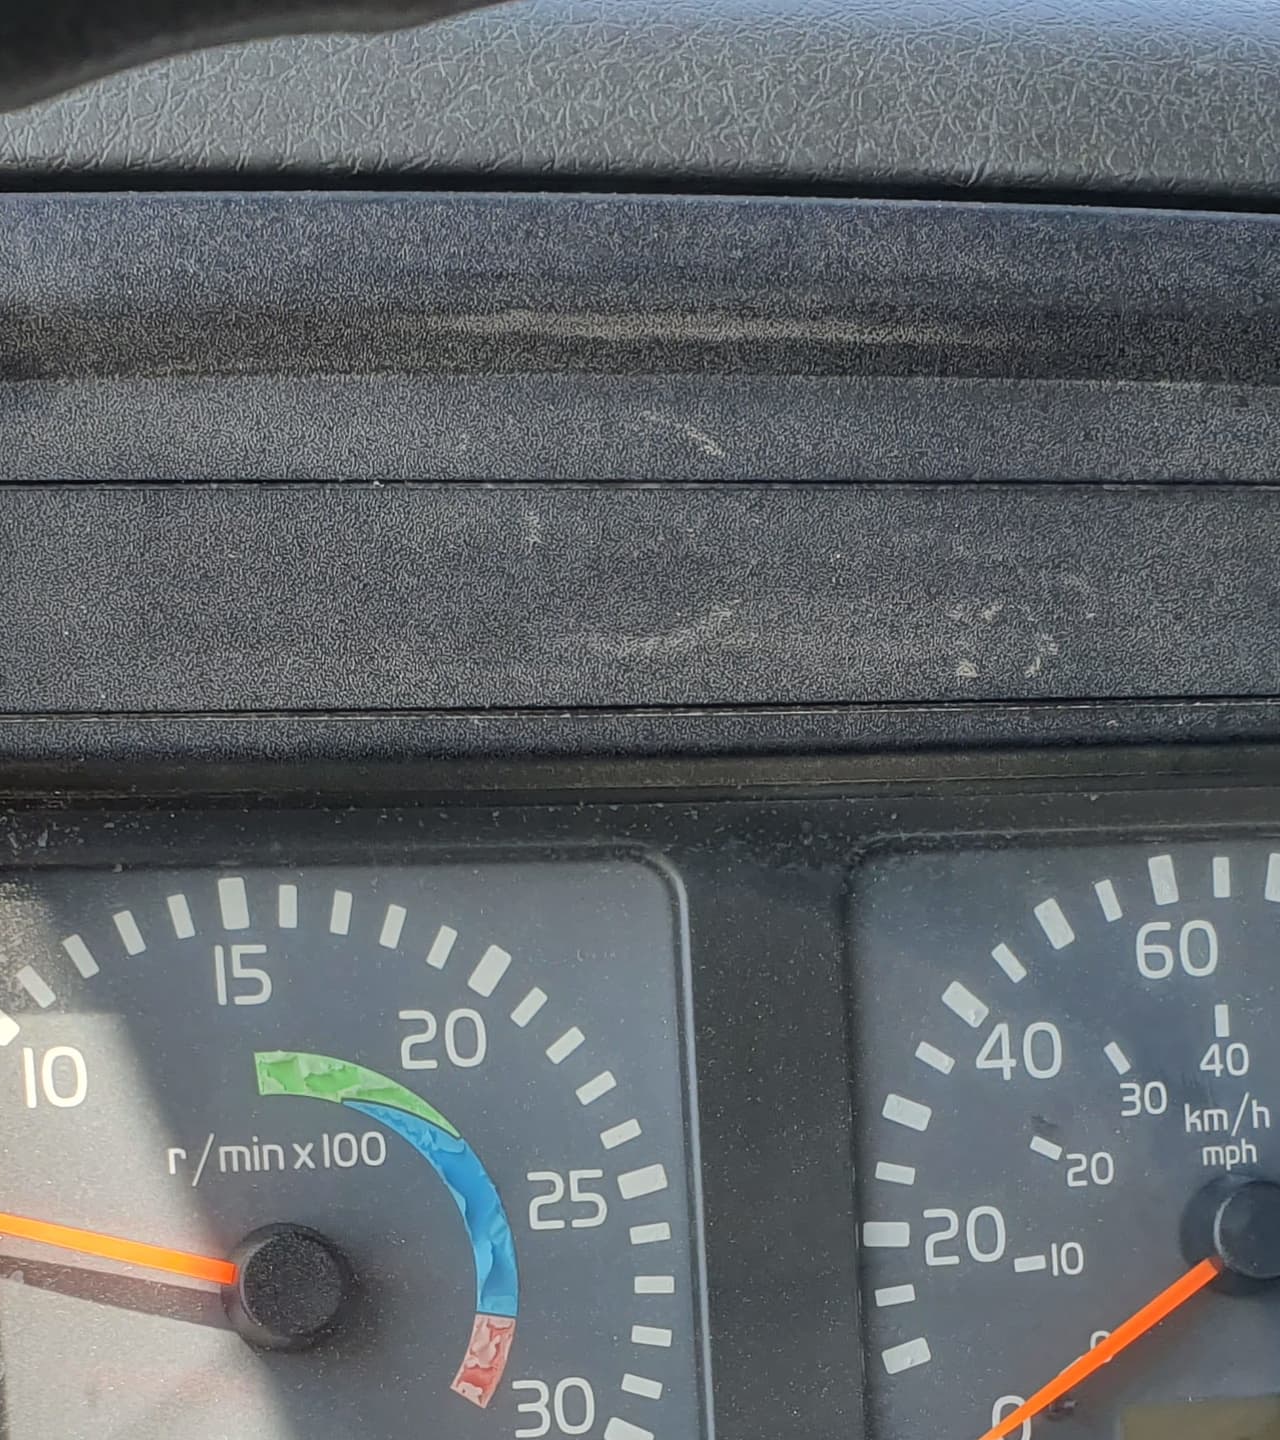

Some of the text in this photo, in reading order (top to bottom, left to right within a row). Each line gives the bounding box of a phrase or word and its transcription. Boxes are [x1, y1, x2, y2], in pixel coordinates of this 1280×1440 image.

[213, 944, 273, 1006] 15
[1135, 920, 1219, 980] 60
[400, 1008, 487, 1070] 20
[975, 1021, 1064, 1082] 40
[1199, 1043, 1251, 1079] 40
[22, 1045, 90, 1109] 10
[1119, 1080, 1169, 1118] 30
[1184, 1092, 1272, 1138] km/h
[1065, 1151, 1115, 1188] 20
[1201, 1138, 1258, 1170] mph
[527, 1169, 608, 1231] 25
[923, 1205, 1006, 1266] 20
[1049, 1241, 1085, 1277] 10
[512, 1377, 596, 1438] 30
